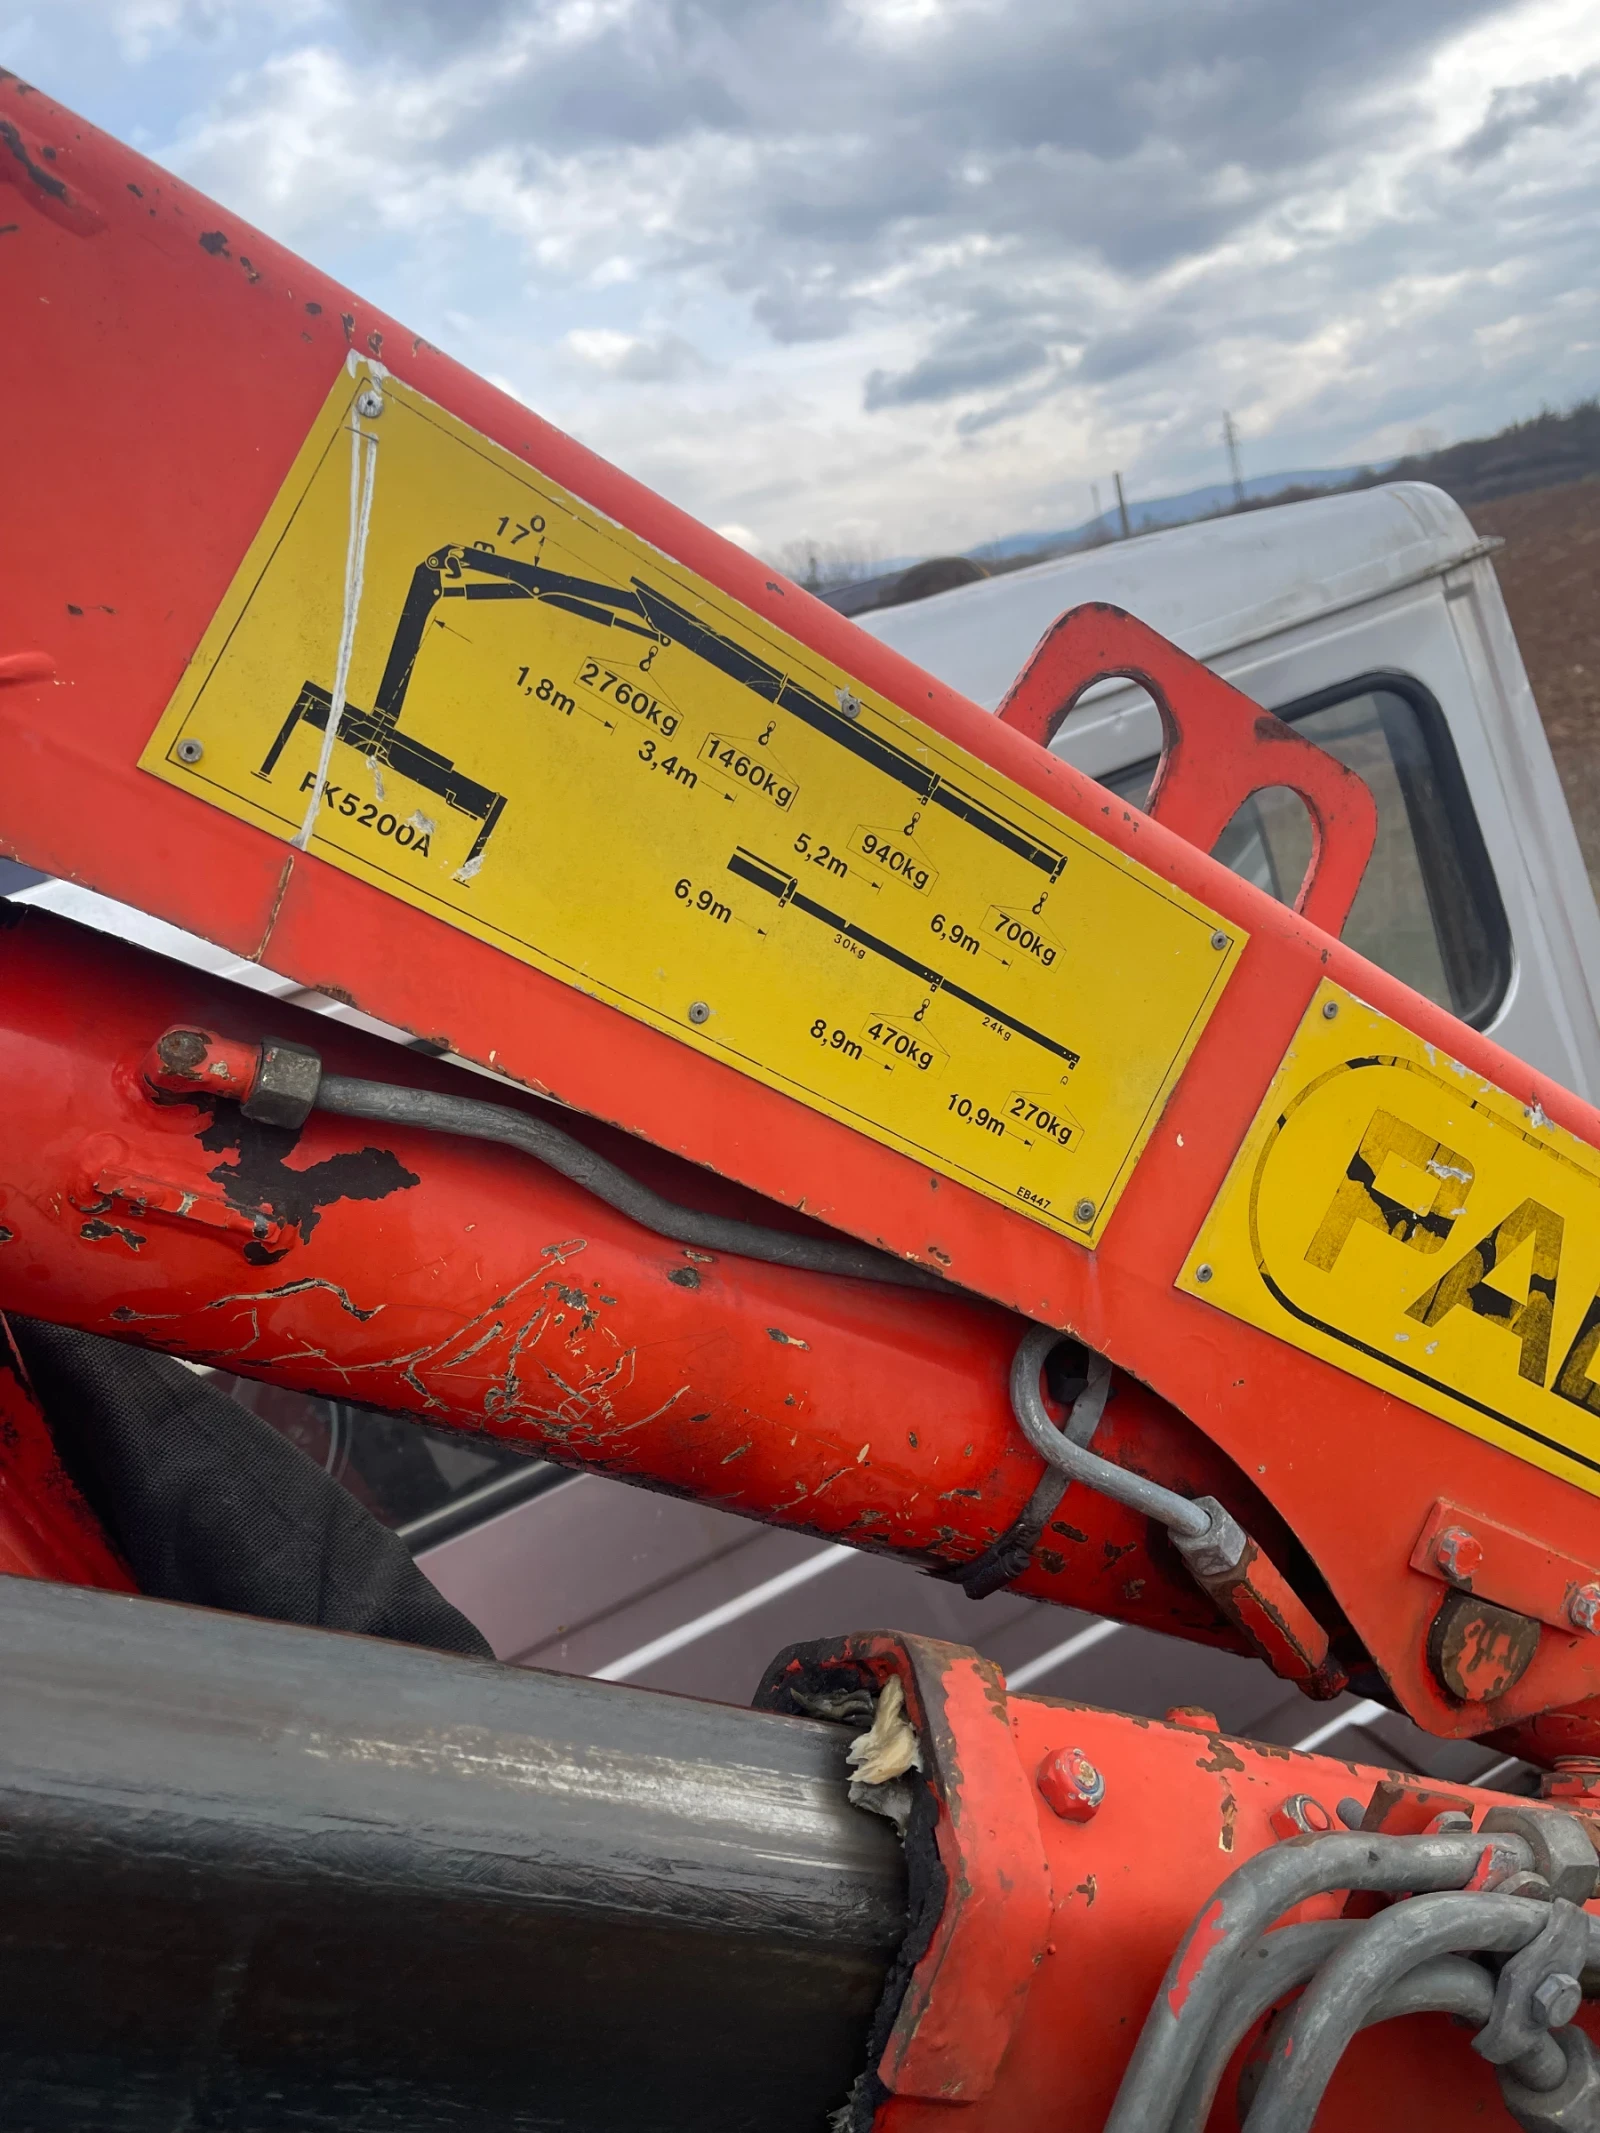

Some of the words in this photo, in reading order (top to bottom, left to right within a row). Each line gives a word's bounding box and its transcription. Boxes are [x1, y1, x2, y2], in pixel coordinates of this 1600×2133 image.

[516, 666, 576, 716] 1,8m
[579, 663, 679, 737] 2760kg
[638, 740, 698, 789] 3,4m
[708, 739, 793, 807] 1460kg
[299, 771, 431, 858] PK5200A
[793, 833, 848, 878] 5,2m
[861, 834, 930, 891] 940kg
[674, 878, 733, 924] 6,9m
[833, 934, 867, 960] 30kg
[930, 913, 981, 956] 6,9m
[992, 914, 1057, 966] 700kg
[810, 1019, 864, 1060] 8,9m
[867, 1023, 934, 1071] 470kg
[982, 1016, 1012, 1041] 24kg
[948, 1093, 1006, 1137] 10,9m
[1010, 1097, 1073, 1145] 270kg
[1016, 1186, 1052, 1210] EB447
